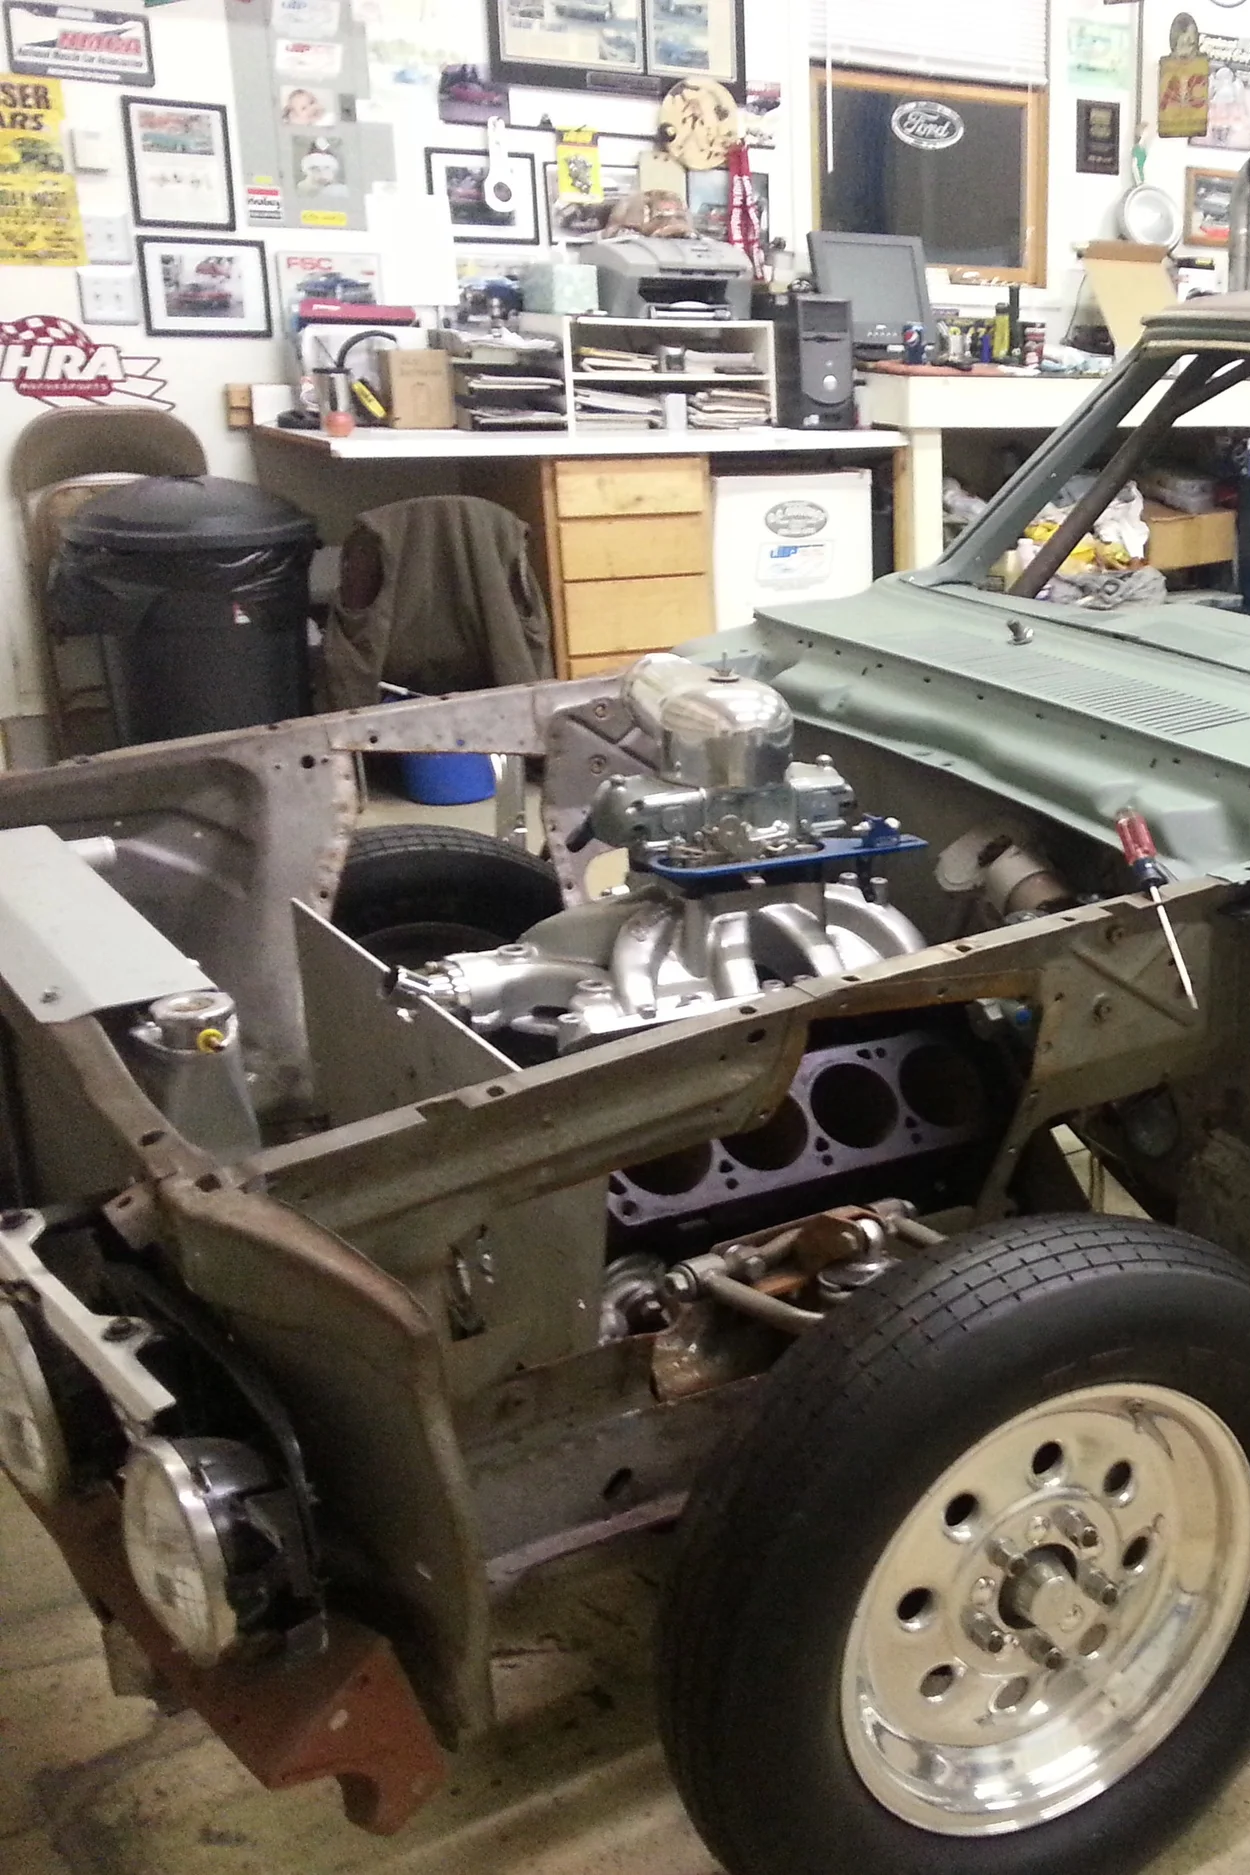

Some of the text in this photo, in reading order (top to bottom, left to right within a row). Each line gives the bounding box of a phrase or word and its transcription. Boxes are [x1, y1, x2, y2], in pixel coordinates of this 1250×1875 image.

[1160, 74, 1206, 111] AC
[903, 111, 951, 138] Ford
[0, 344, 123, 379] HRA
